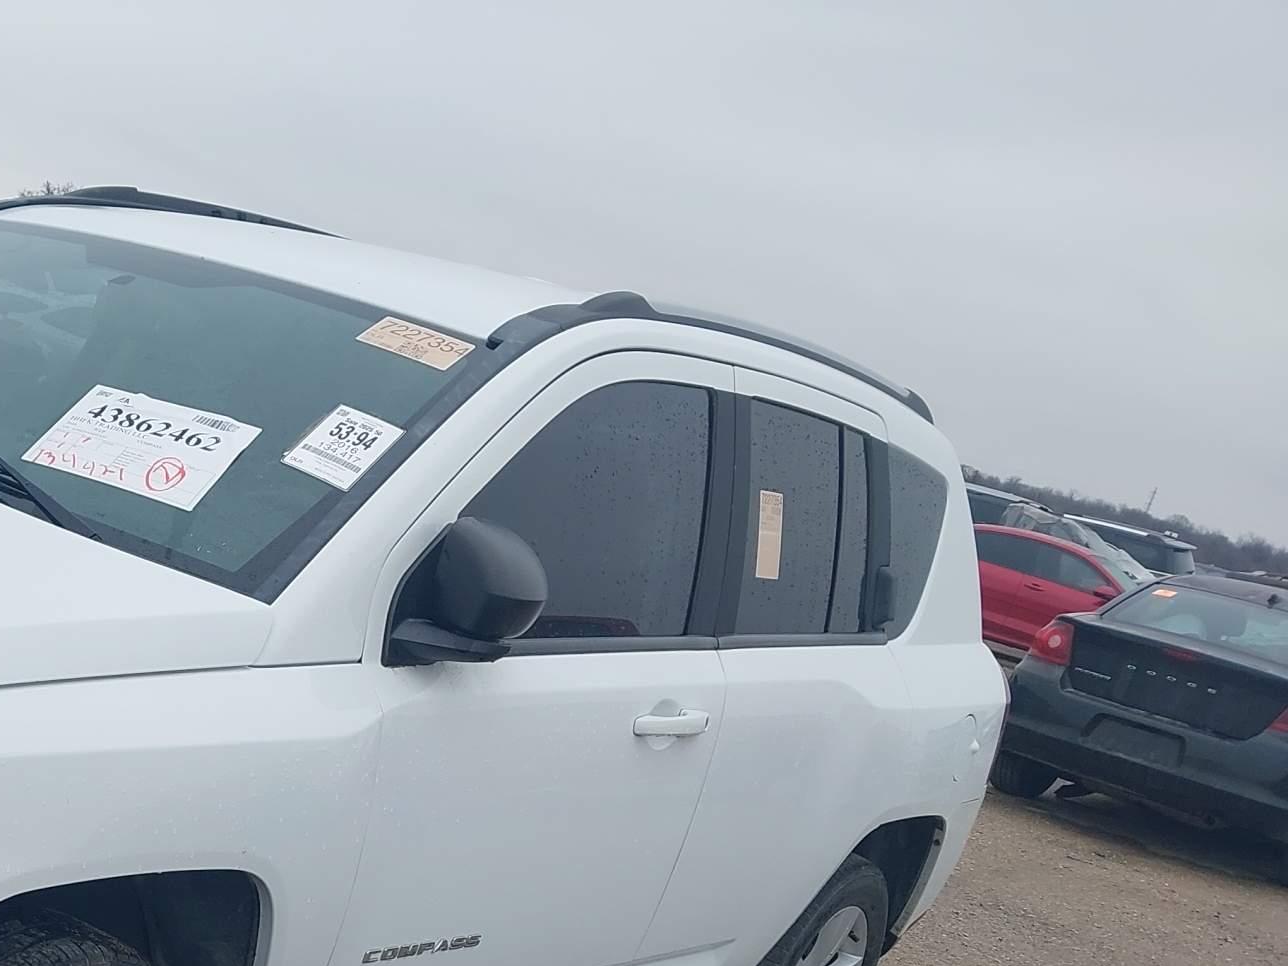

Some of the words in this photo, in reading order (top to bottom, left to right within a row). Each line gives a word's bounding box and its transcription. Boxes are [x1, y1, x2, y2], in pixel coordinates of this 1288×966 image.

[379, 320, 470, 357] 7227354
[88, 404, 222, 453] 43862462
[329, 421, 379, 450] 53:94
[361, 934, 482, 964] COMPASS
